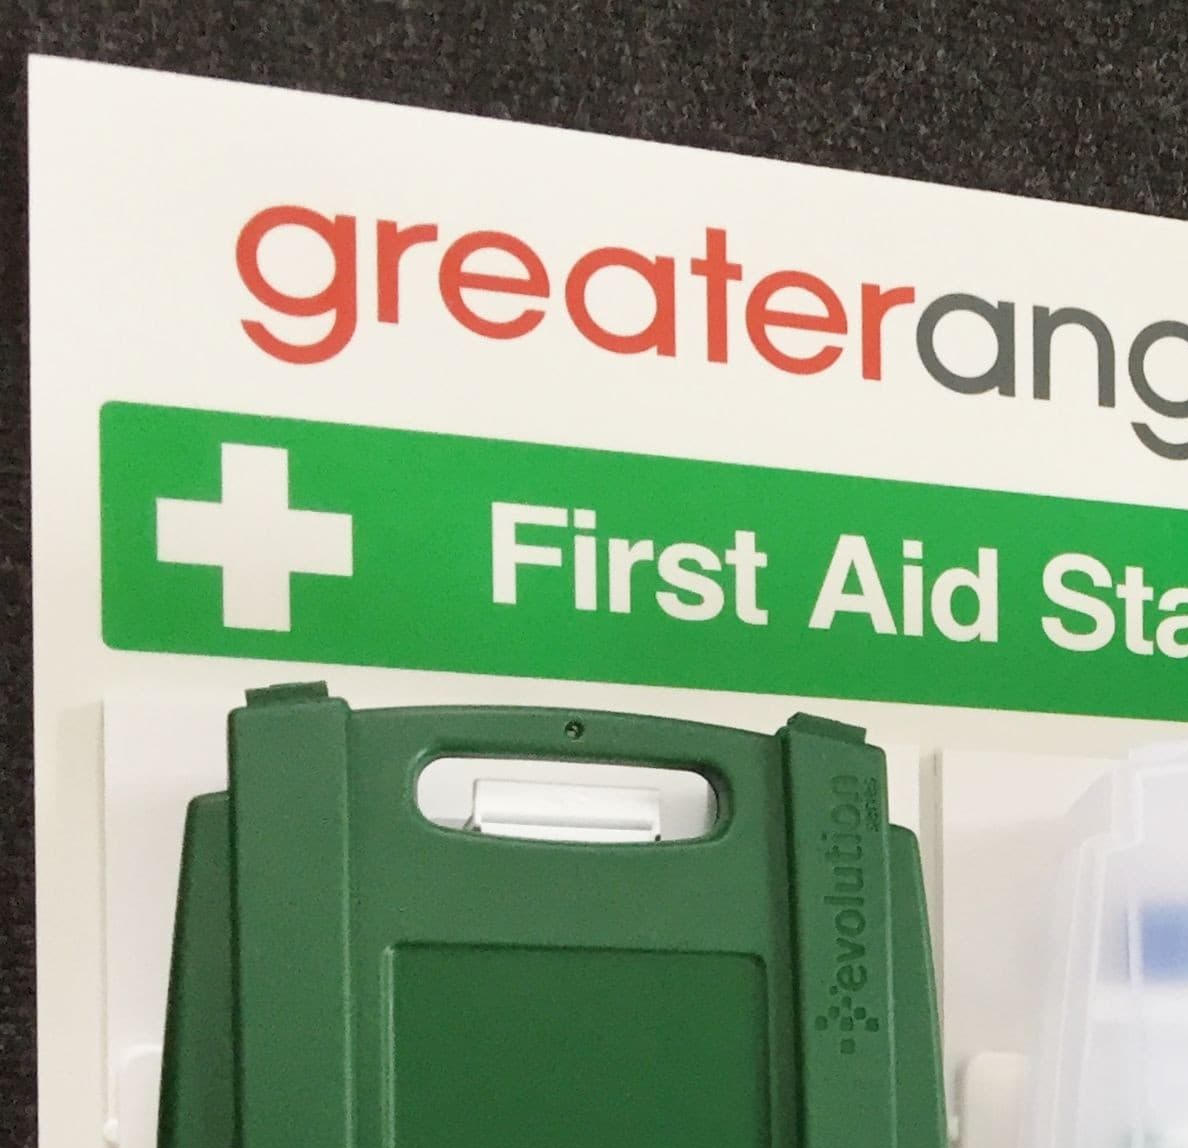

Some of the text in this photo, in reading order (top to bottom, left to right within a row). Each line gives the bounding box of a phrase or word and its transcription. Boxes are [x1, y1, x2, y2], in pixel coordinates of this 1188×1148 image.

[490, 501, 769, 626] First
[808, 533, 999, 643] Aid
[821, 774, 868, 992] evolution
